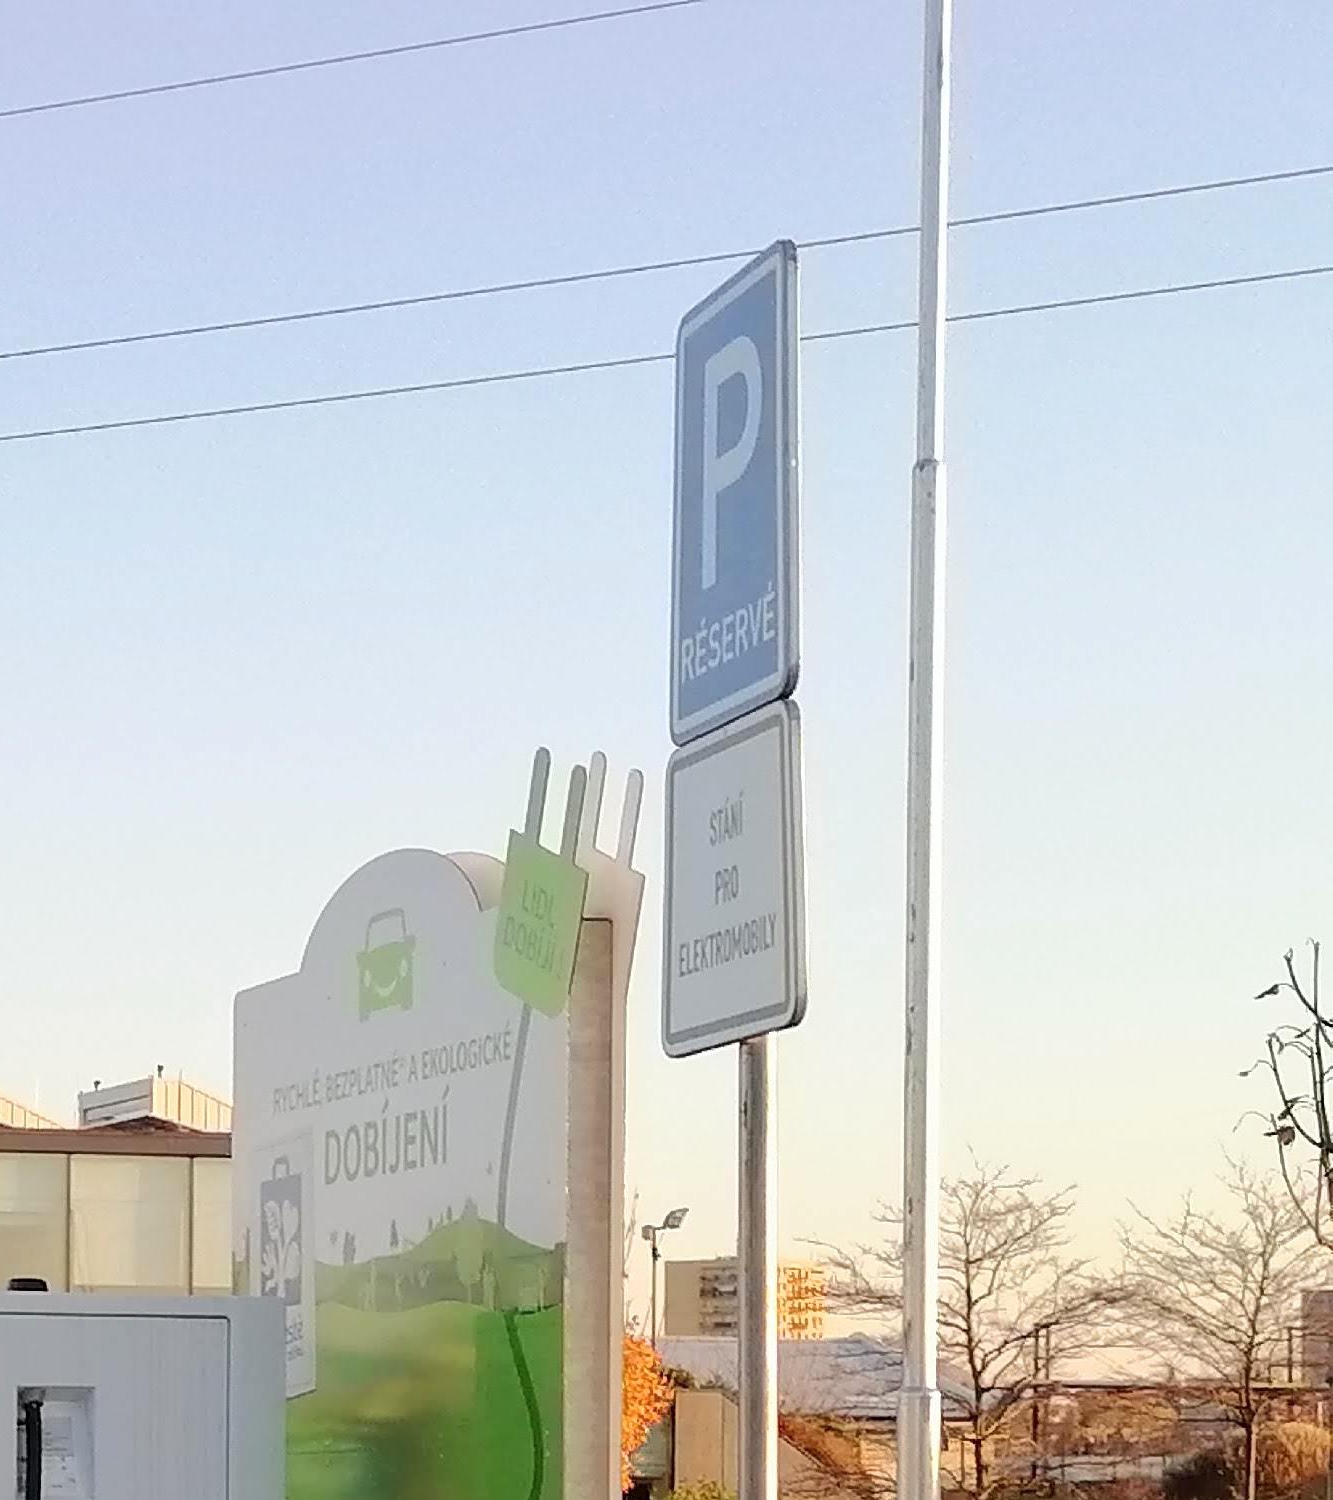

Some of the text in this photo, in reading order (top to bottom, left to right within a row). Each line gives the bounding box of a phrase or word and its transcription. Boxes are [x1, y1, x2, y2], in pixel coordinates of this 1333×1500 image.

[702, 335, 763, 590] P
[681, 581, 776, 684] RÉSERVÉ
[709, 790, 744, 846] STÁNÍ
[715, 865, 740, 905] PRO
[678, 913, 777, 978] ELEKTROMOBILY
[408, 1055, 419, 1083] A
[421, 1019, 513, 1080] EKOLOGICKÉ
[325, 1084, 451, 1185] DOBÍJENÍ
